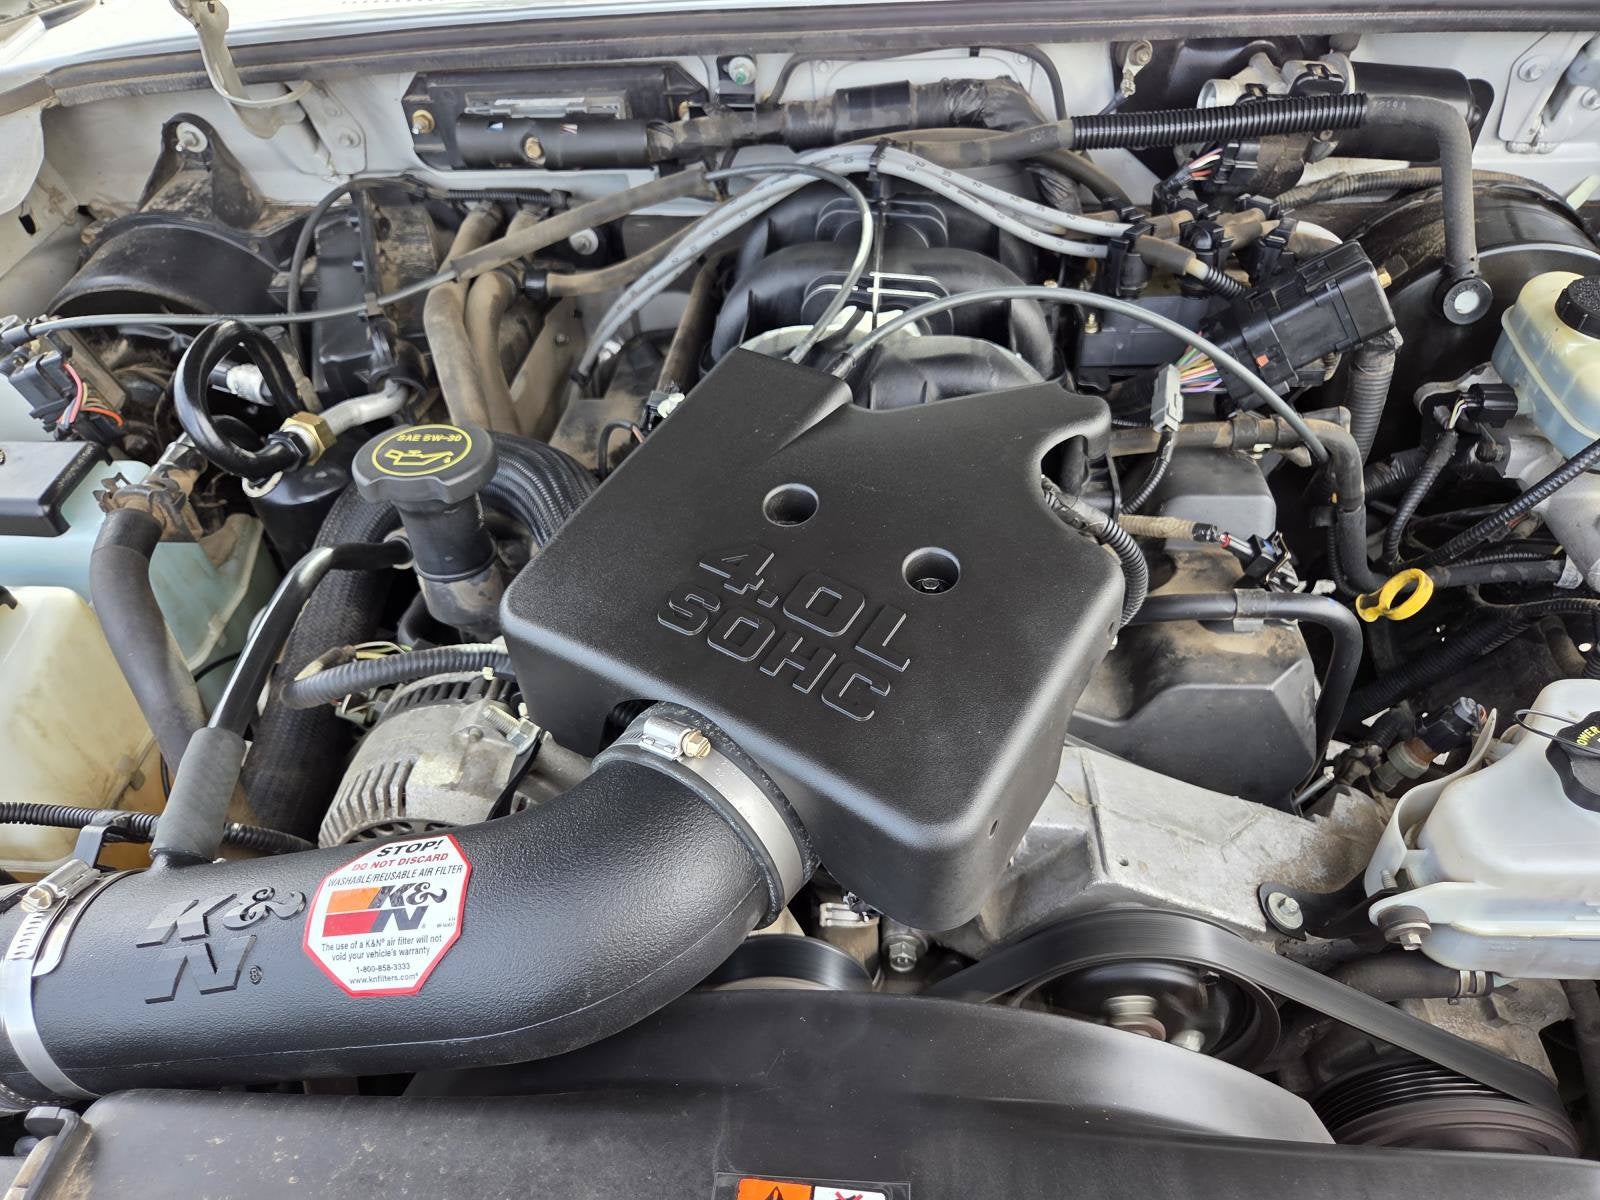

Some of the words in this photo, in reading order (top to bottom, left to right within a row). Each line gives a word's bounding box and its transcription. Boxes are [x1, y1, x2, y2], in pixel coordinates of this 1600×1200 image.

[397, 434, 421, 442] SAE
[422, 433, 462, 442] 5W-30
[698, 545, 911, 673] 4.0L
[657, 583, 891, 722] SOHC
[1576, 725, 1599, 746] OWER
[377, 839, 444, 857] STOP!
[352, 863, 369, 871] DO
[371, 859, 397, 869] NOT
[397, 852, 449, 866] DISCARD
[328, 869, 418, 887] WASHABLE/REUSABLE
[418, 867, 435, 877] AIR
[435, 864, 464, 875] FILTER
[321, 943, 334, 951] The
[335, 943, 349, 951] use
[350, 940, 358, 949] of
[386, 939, 396, 947] air
[397, 936, 415, 946] filter
[416, 934, 429, 944] will
[430, 935, 442, 943] not
[332, 951, 347, 961] void
[348, 952, 364, 963] your
[365, 948, 397, 958] vehicle's
[398, 946, 430, 956] warranty
